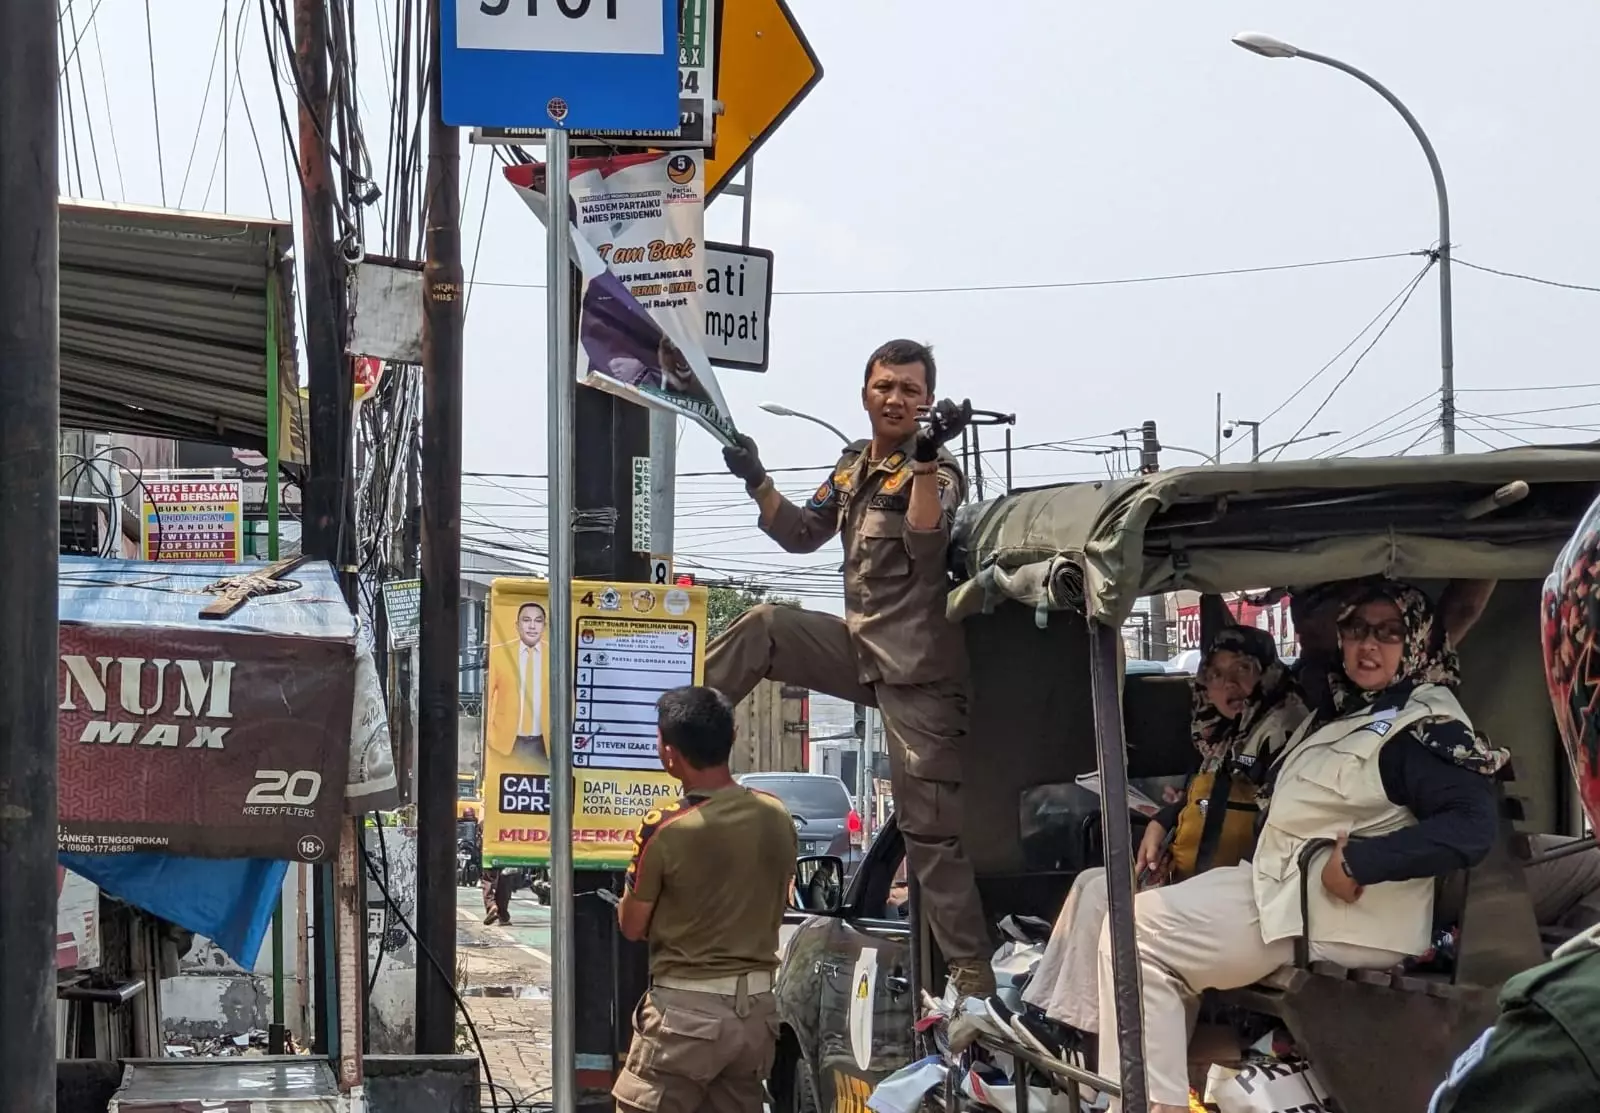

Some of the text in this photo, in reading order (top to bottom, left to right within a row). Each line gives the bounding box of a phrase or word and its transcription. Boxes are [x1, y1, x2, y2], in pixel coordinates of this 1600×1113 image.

[691, 48, 700, 65] X
[677, 157, 685, 170] 5
[582, 203, 617, 214] NASDEM
[619, 199, 660, 210] PARTAIKU
[582, 209, 662, 224] ANIES PRESIDENKU
[613, 247, 645, 264] am
[647, 238, 696, 263] Back
[634, 269, 692, 281] MELANGKAH
[705, 263, 745, 296] ati
[653, 297, 688, 308] Rakyat
[705, 310, 758, 346] mpat
[634, 459, 643, 496] WC
[143, 483, 238, 494] PERCETAKAN
[143, 492, 238, 502] CIPTA BERSAMA
[160, 523, 224, 531] SPANDUK
[186, 541, 225, 549] SURAT
[580, 591, 594, 607] 4
[629, 622, 666, 630] PEMILIHAN
[583, 653, 592, 665] 4
[580, 673, 586, 682] 1
[58, 655, 236, 718] NUM
[580, 689, 586, 698] 2
[580, 706, 586, 715] 3
[578, 722, 585, 732] 4
[80, 720, 232, 749] MAX
[596, 741, 627, 749] STEVEN
[627, 742, 649, 750] IZAAC
[577, 754, 584, 764] 6
[245, 769, 322, 806] 20
[583, 780, 622, 795] DAPIL
[625, 783, 671, 796] JABAR
[583, 795, 655, 806] KOTA BEKASI
[242, 806, 316, 818] KRETEK FILTERS
[582, 806, 612, 815] KOTA
[96, 835, 169, 845] TENGGOROKAN
[500, 828, 550, 842] MUD
[300, 840, 321, 854] 18+
